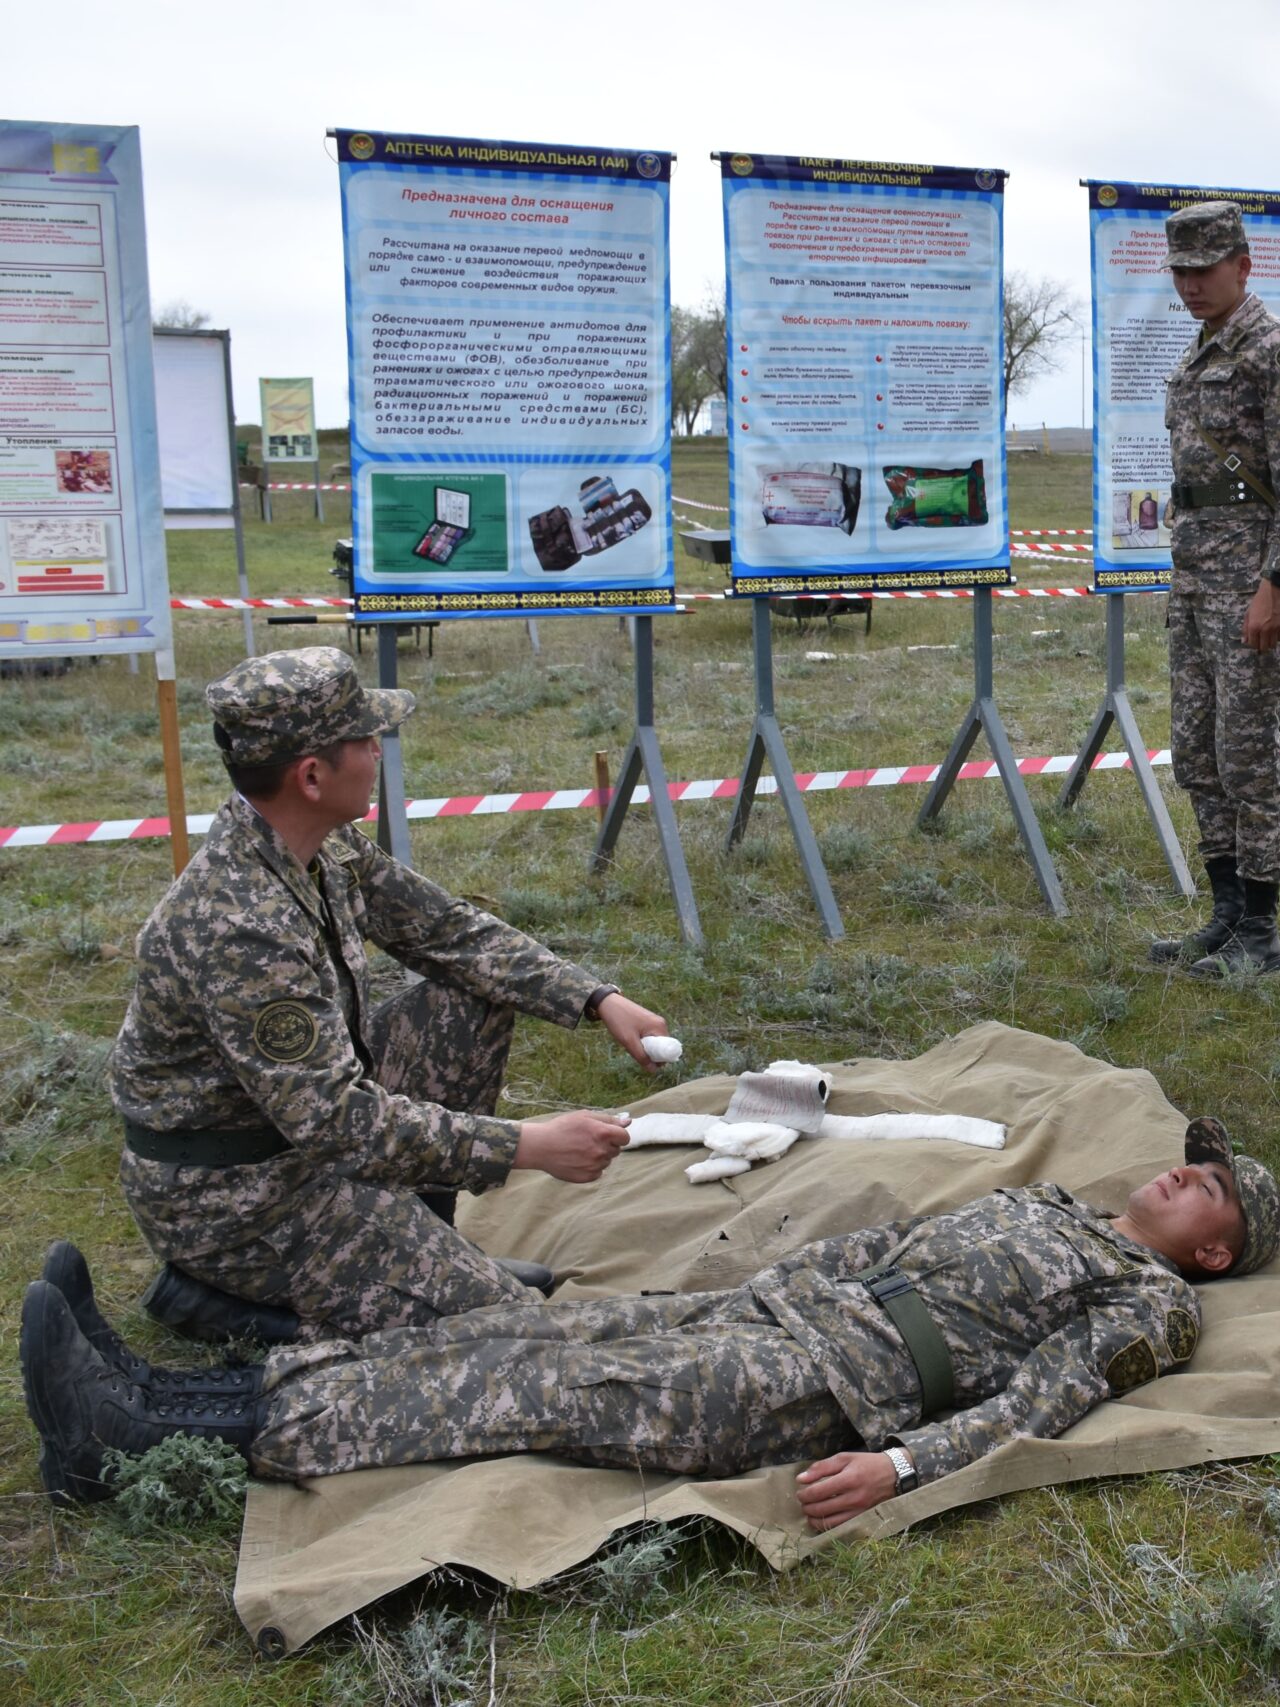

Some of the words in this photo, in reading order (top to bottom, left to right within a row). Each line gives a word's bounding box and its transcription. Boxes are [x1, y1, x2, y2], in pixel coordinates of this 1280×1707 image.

[385, 142, 454, 157] АПТЕЧКА
[458, 147, 596, 166] ИНДИВИДУАЛЬНАЯ
[600, 156, 629, 170] (АИ)
[799, 158, 836, 167] ПАКЕТ
[841, 161, 933, 173] ПЕРЕВЯЗОЧНЫЙ
[813, 170, 921, 185] ИНДИВИДУАЛЬНЫЙ
[1141, 187, 1173, 196] ПАКЕТ
[402, 189, 506, 205] Предназначена
[511, 195, 536, 207] для
[539, 199, 613, 210] оснащения
[449, 210, 507, 220] личного
[510, 213, 568, 223] состава
[1130, 230, 1168, 238] Предназн
[382, 238, 450, 250] Рассчитана
[469, 244, 520, 253] оказание
[523, 247, 563, 255] первой
[569, 249, 632, 259] медпомощи
[368, 251, 414, 261] порядке
[465, 257, 554, 267] взаимопомощи,
[557, 260, 646, 271] предупреждение
[410, 267, 465, 275] снижение
[484, 270, 559, 279] воздействия
[577, 273, 646, 283] поражающих
[769, 277, 805, 285] Правила
[400, 278, 457, 288] факторов
[461, 281, 537, 290] современных
[540, 283, 574, 292] видов
[577, 285, 617, 294] оружия.
[372, 314, 464, 325] Обеспечивает
[469, 319, 545, 328] применение
[550, 322, 620, 331] антидотов
[624, 322, 647, 332] для
[782, 315, 811, 324] Чтобы
[372, 328, 466, 338] профилактики
[577, 334, 646, 343] поражениях
[372, 340, 532, 352] фосфорорганическими
[542, 346, 647, 355] отравляющими
[372, 353, 456, 362] веществами
[465, 354, 505, 364] (ФОВ),
[514, 356, 609, 366] обезболивание
[625, 360, 647, 368] при
[548, 370, 647, 378] предупреждения
[374, 378, 495, 387] травматического
[374, 390, 469, 399] радиационных
[374, 402, 501, 411] бактериальными
[615, 404, 646, 414] (БС),
[375, 415, 510, 423] обеззараживание
[427, 426, 463, 435] воды.
